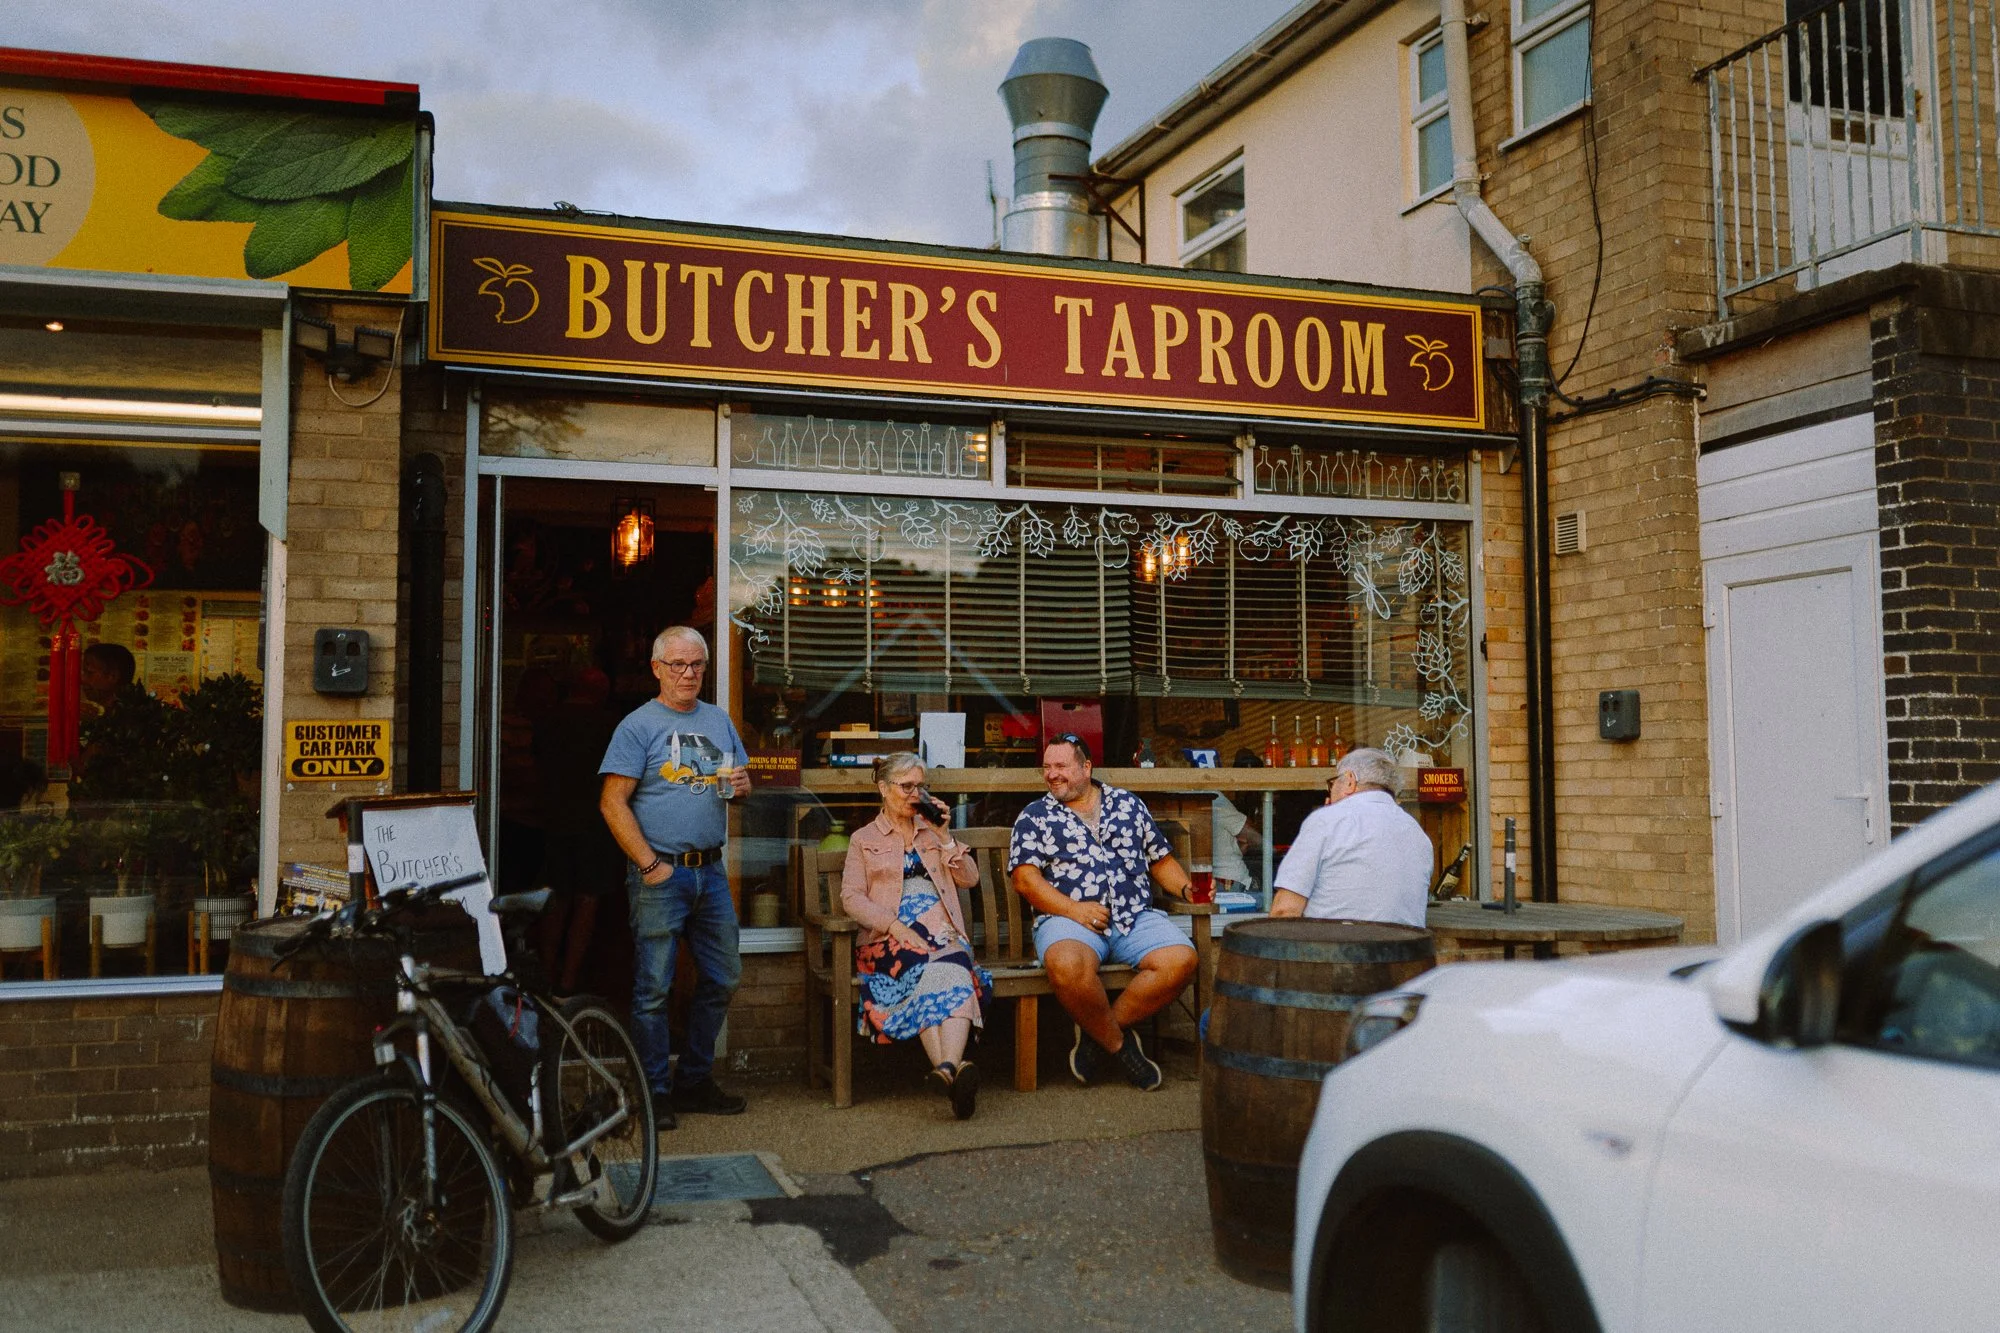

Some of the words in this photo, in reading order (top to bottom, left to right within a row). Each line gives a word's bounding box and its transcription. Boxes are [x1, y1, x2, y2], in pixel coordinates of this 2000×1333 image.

[0, 106, 26, 140] S
[0, 200, 52, 234] AY
[565, 254, 1002, 369] BUTCHER'S
[1054, 295, 1388, 396] TAPROOM
[294, 725, 382, 741] CUSTOMER
[300, 741, 332, 757] CAR
[334, 741, 377, 756] PARK
[301, 759, 375, 776] ONLY
[748, 756, 770, 764] MOKING
[1423, 773, 1459, 785] SMOKERS
[375, 823, 397, 844] THE
[377, 849, 463, 884] BUTCHER'S
